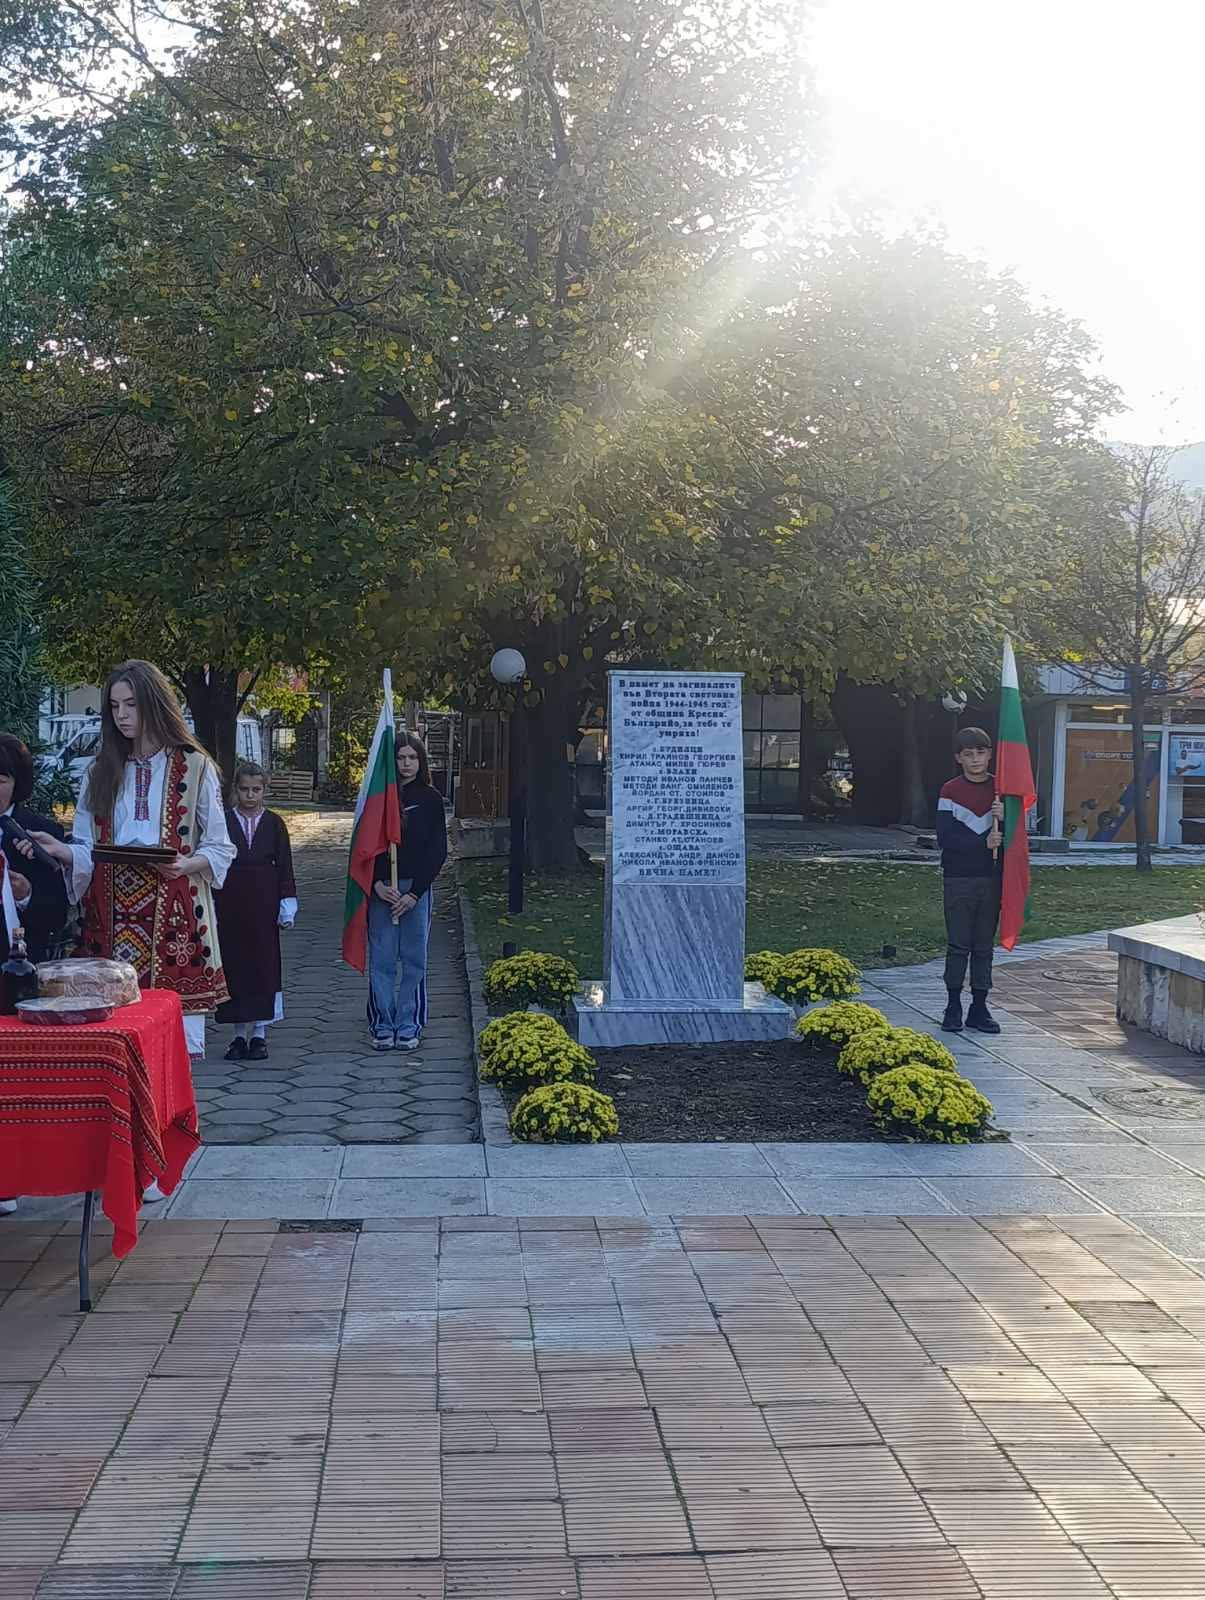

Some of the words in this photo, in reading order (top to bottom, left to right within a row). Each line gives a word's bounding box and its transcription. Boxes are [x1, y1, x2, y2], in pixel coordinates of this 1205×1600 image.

[619, 680, 626, 688] В
[645, 690, 686, 699] Втората
[645, 710, 684, 718] община
[658, 729, 700, 738] умряха!
[639, 868, 674, 876] ВЕЧНА
